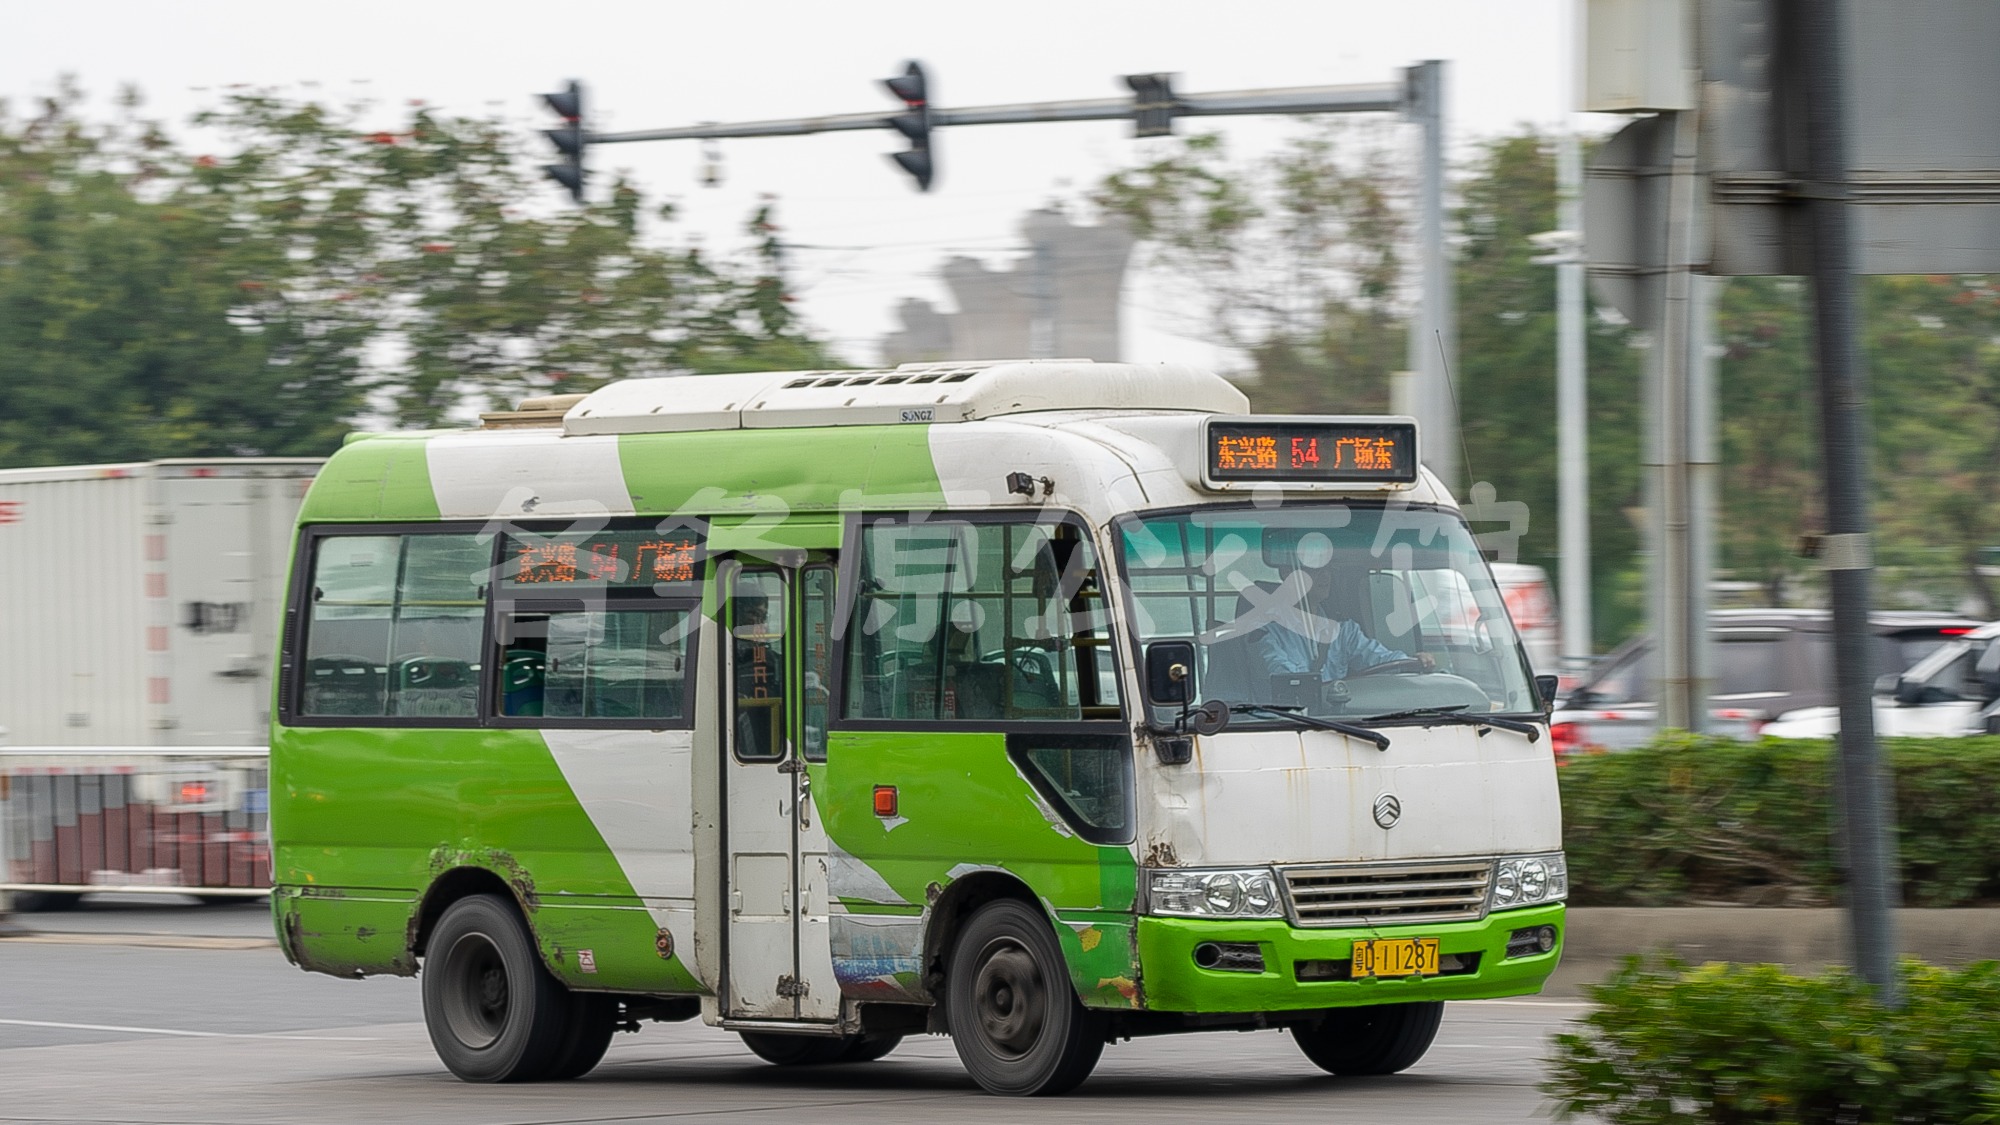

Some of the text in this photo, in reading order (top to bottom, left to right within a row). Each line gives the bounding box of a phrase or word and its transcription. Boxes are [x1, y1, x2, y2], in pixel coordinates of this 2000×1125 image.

[901, 410, 933, 422] SONGZ
[1218, 436, 1395, 469] 东兴路 54 广场东
[590, 544, 618, 580] 54
